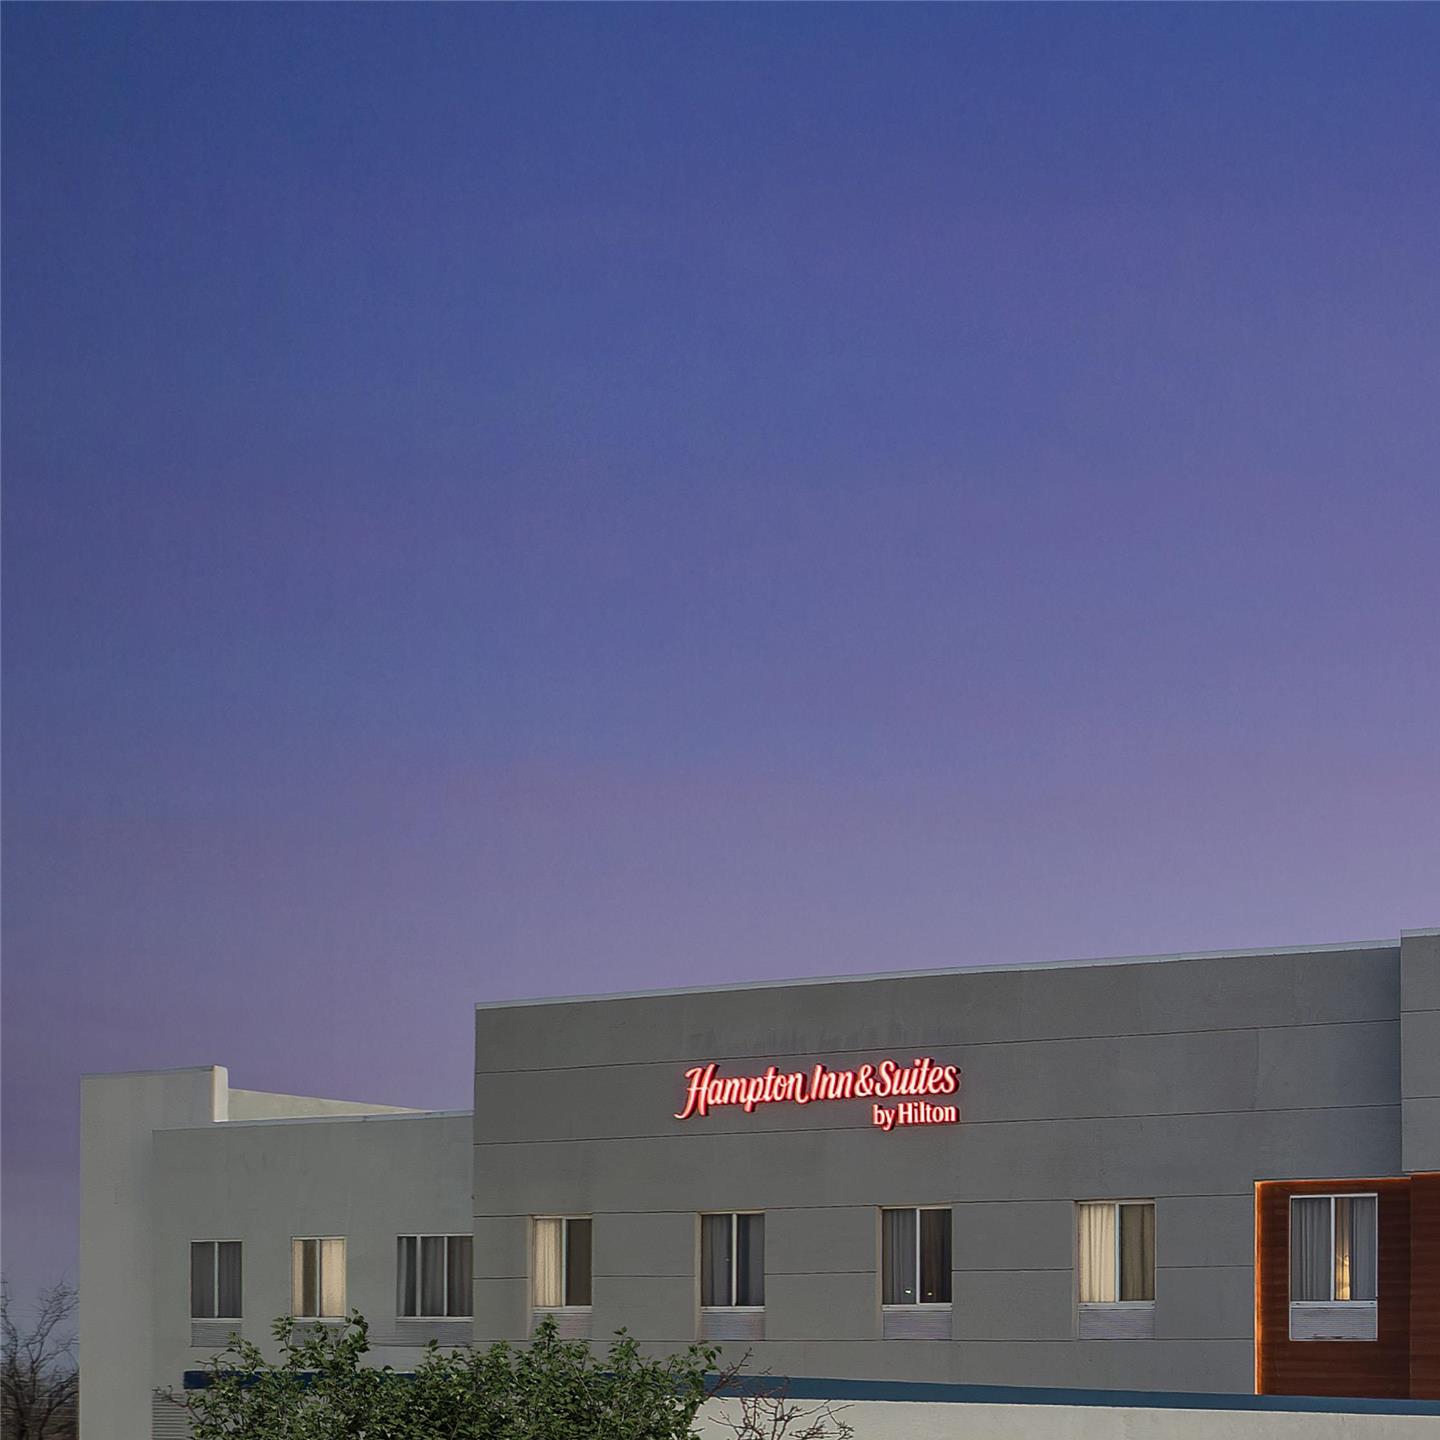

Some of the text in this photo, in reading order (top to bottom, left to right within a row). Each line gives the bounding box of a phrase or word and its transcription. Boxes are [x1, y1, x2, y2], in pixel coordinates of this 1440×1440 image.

[673, 1063, 810, 1120] Hampton
[810, 1064, 855, 1101] Inn
[874, 1057, 961, 1098] Suites
[872, 1101, 959, 1131] by Hilton
